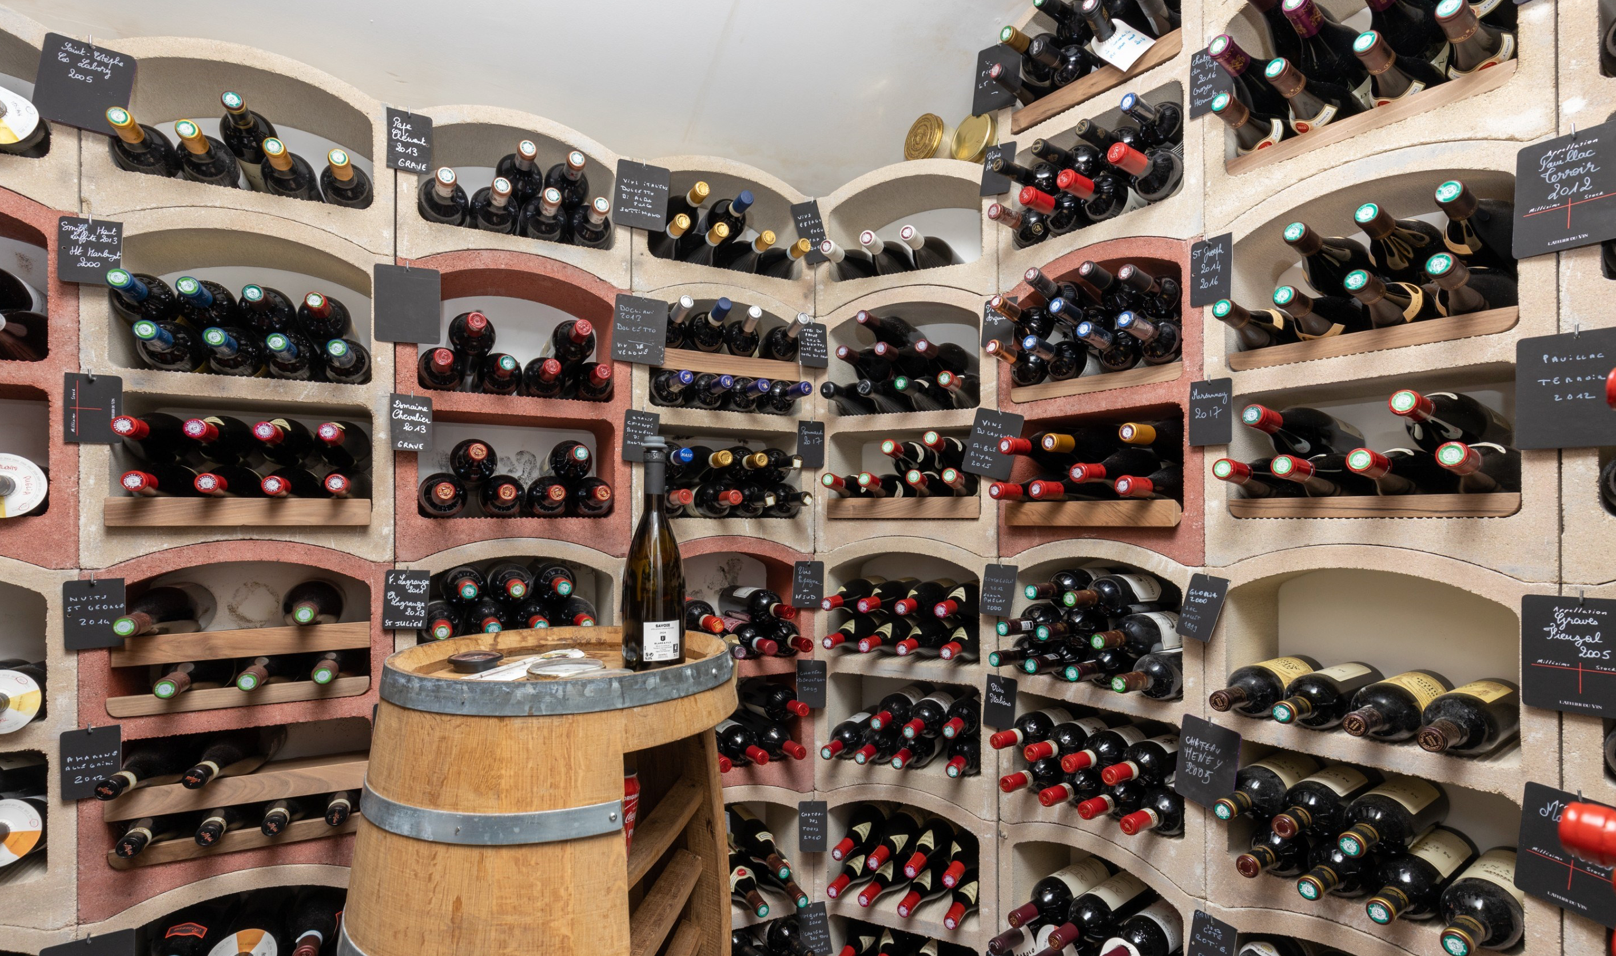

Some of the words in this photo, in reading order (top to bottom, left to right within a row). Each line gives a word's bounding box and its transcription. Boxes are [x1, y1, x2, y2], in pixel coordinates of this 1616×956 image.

[68, 68, 93, 83] 2005
[1197, 72, 1217, 85] 2016
[395, 142, 418, 157] 2013
[1547, 138, 1599, 157] Appellation
[398, 158, 427, 171] GRAVE
[1538, 149, 1596, 172] Pauillac
[1540, 161, 1601, 184] Terroir
[1547, 176, 1593, 200] 2012
[1584, 191, 1604, 199] Stock
[1528, 203, 1561, 214] Millésime
[100, 235, 118, 245] 2013
[1192, 249, 1202, 260] ST
[77, 257, 101, 268] 2000
[1199, 276, 1219, 290] 2016
[1554, 391, 1597, 402] 2012
[393, 400, 428, 413] Domaine
[1194, 405, 1222, 419] 2017
[403, 424, 427, 434] 2013
[397, 441, 424, 450] GRAVE
[803, 437, 823, 446] 2017
[971, 460, 992, 469] 2015
[1190, 596, 1208, 604] 2000
[1553, 606, 1608, 616] Appellation
[1554, 612, 1599, 631] Graves
[1578, 646, 1612, 660] 2005
[1537, 659, 1571, 667] Millésime
[1185, 735, 1222, 755] CHATEAU
[1531, 847, 1564, 862] Millésime
[1586, 866, 1606, 878] Stock
[1576, 901, 1588, 911] VIN
